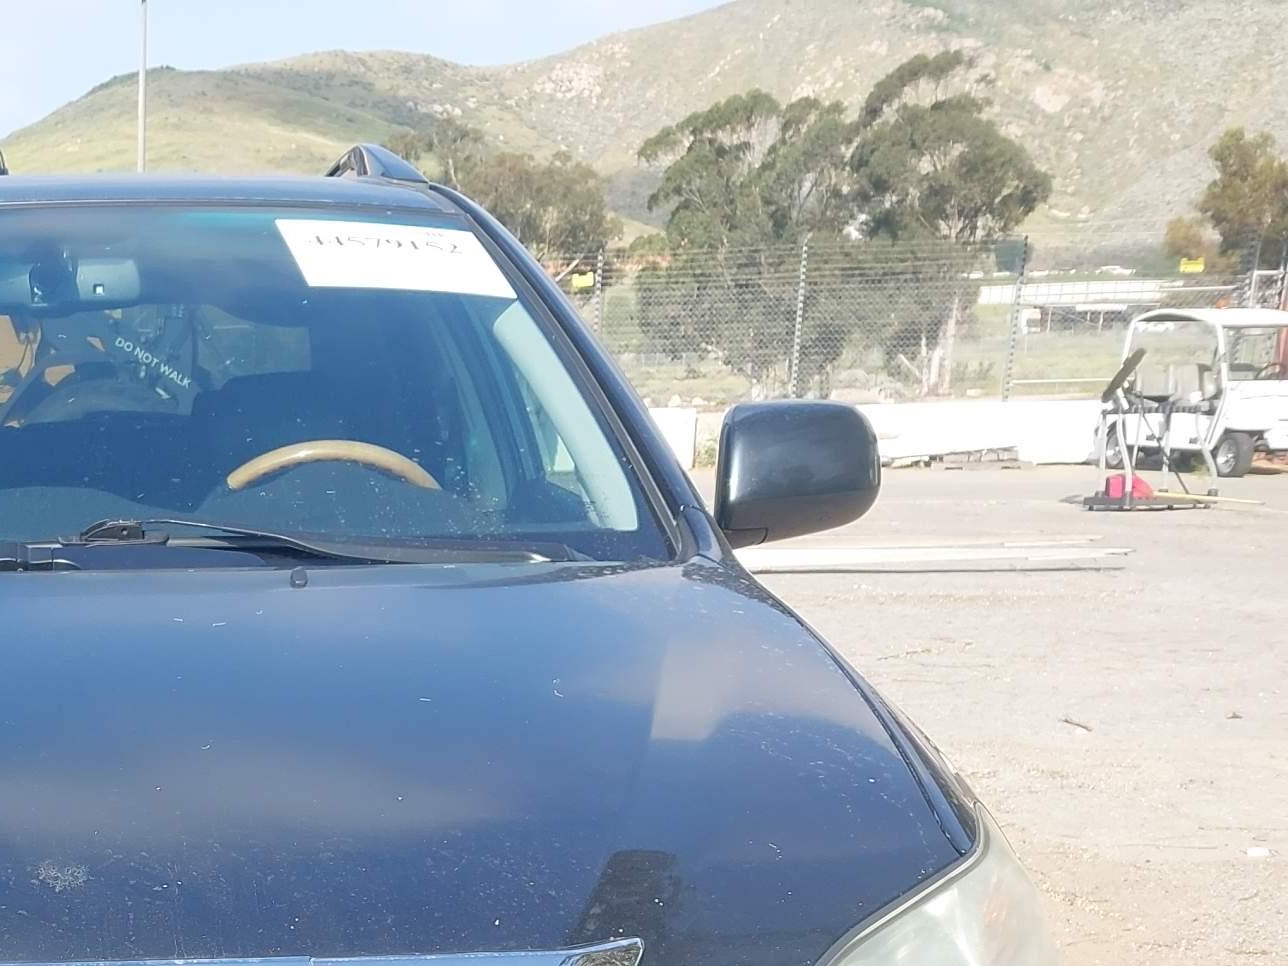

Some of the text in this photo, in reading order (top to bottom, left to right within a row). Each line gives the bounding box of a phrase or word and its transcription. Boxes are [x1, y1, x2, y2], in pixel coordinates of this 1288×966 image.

[115, 337, 191, 389] DO NOT WALK
